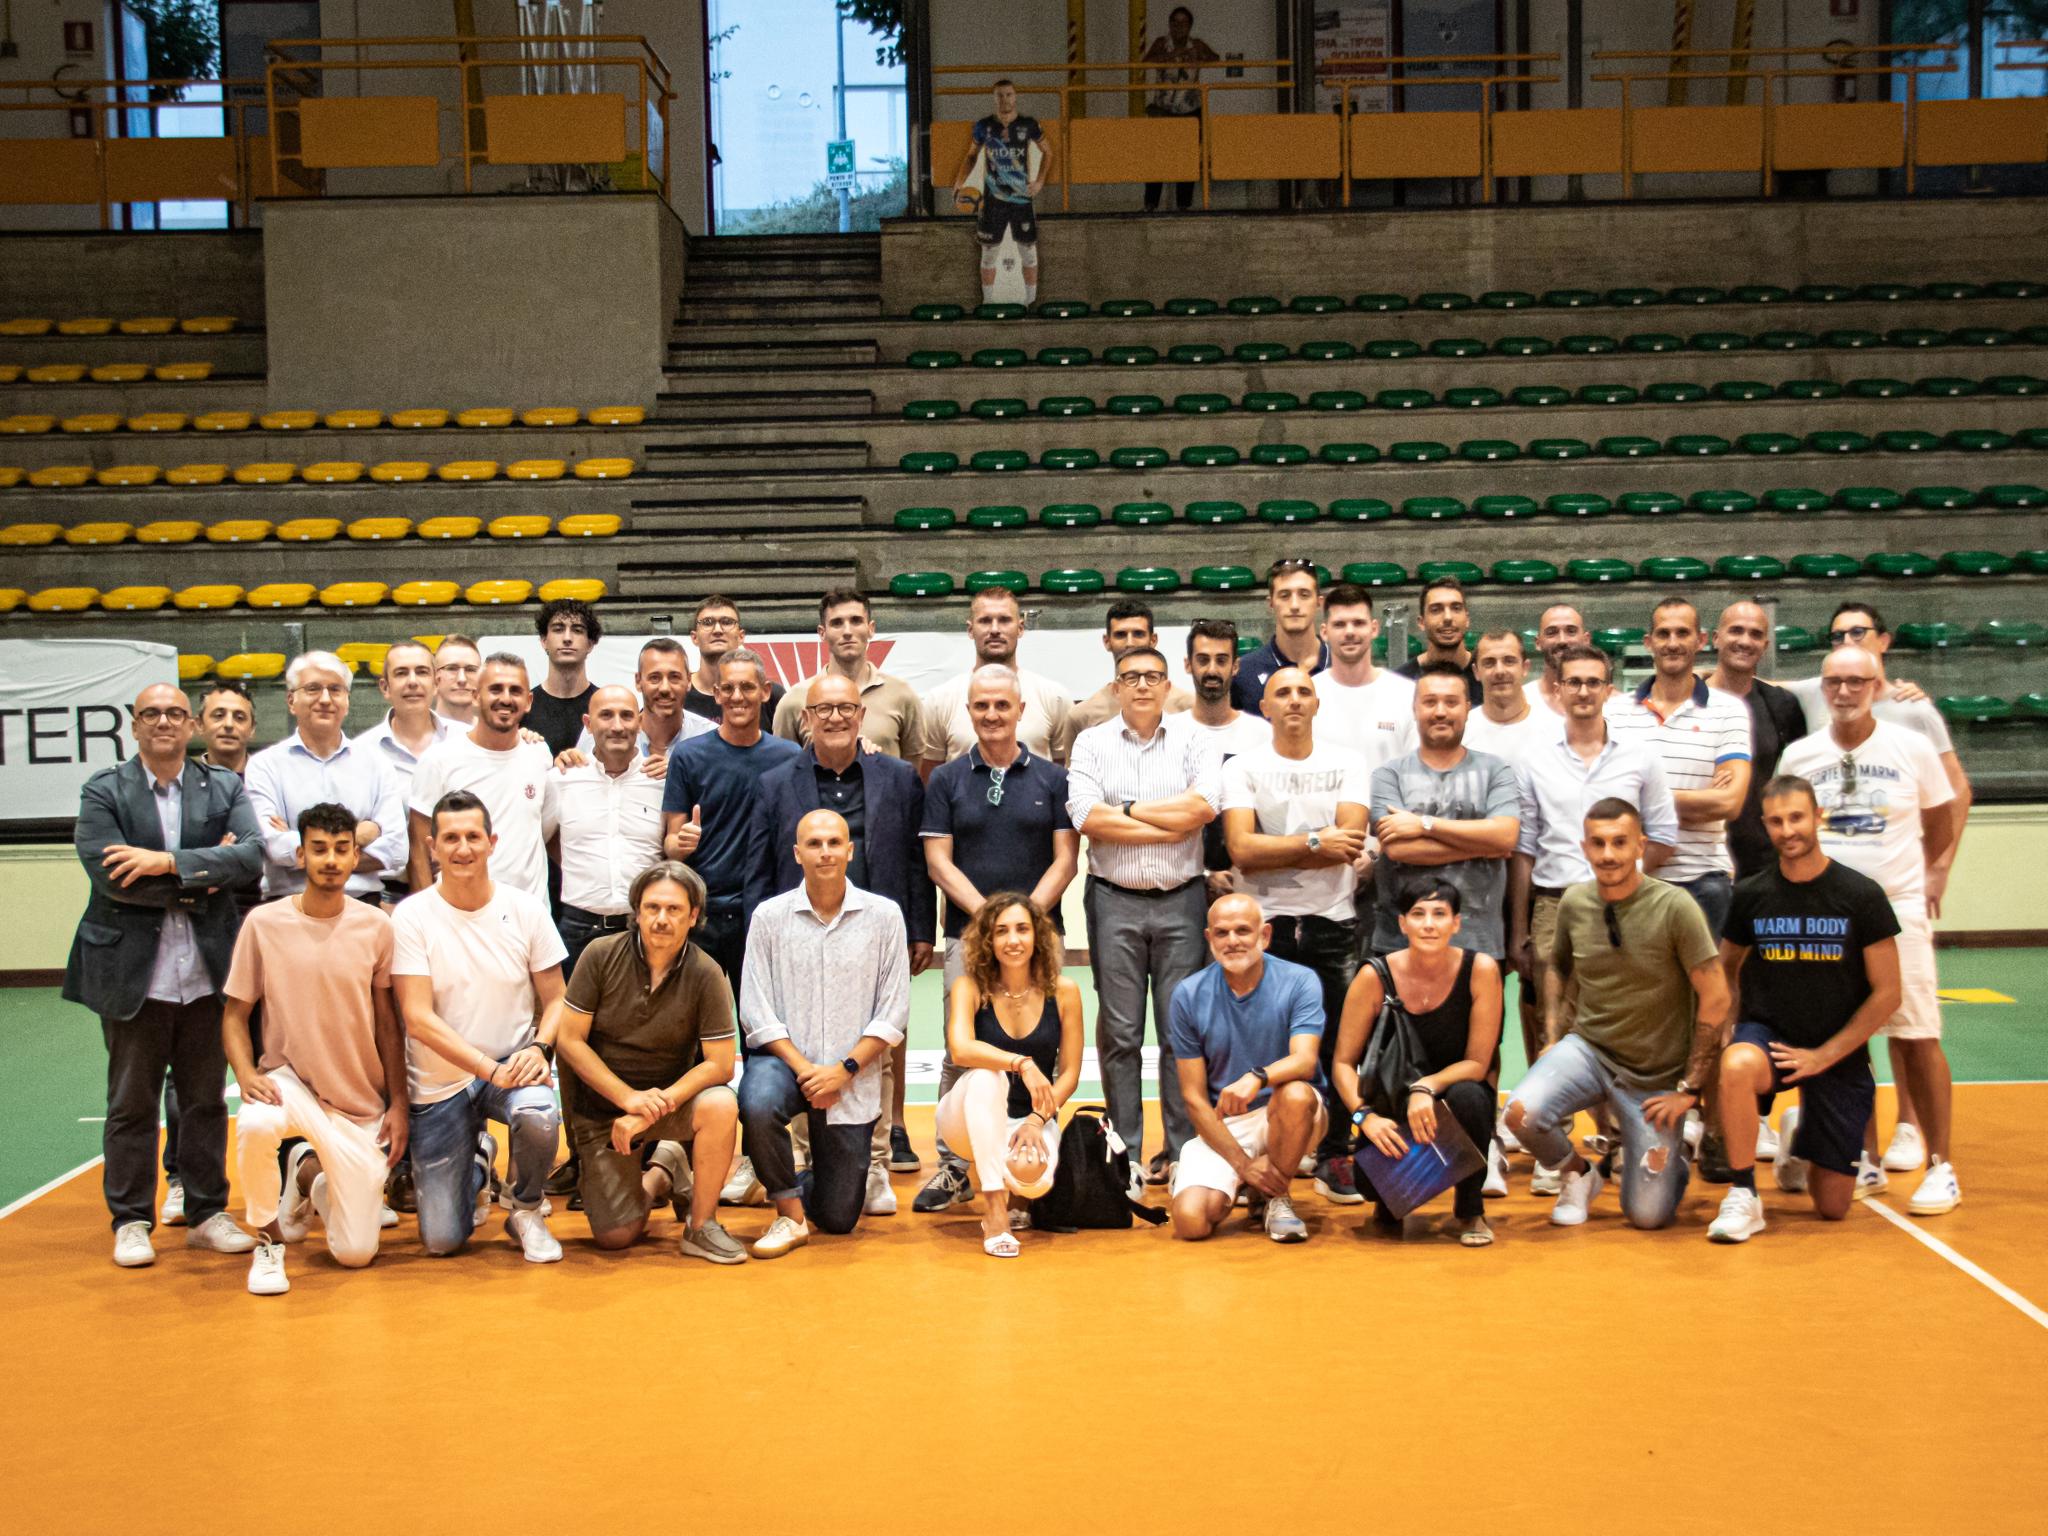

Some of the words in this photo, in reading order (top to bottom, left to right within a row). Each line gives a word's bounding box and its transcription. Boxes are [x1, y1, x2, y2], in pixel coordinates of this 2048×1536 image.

[986, 147, 1025, 158] VIDEX
[0, 701, 137, 765] TER
[1753, 918, 1800, 935] WARM
[1806, 917, 1849, 935] BODY
[1799, 943, 1844, 961] MIND
